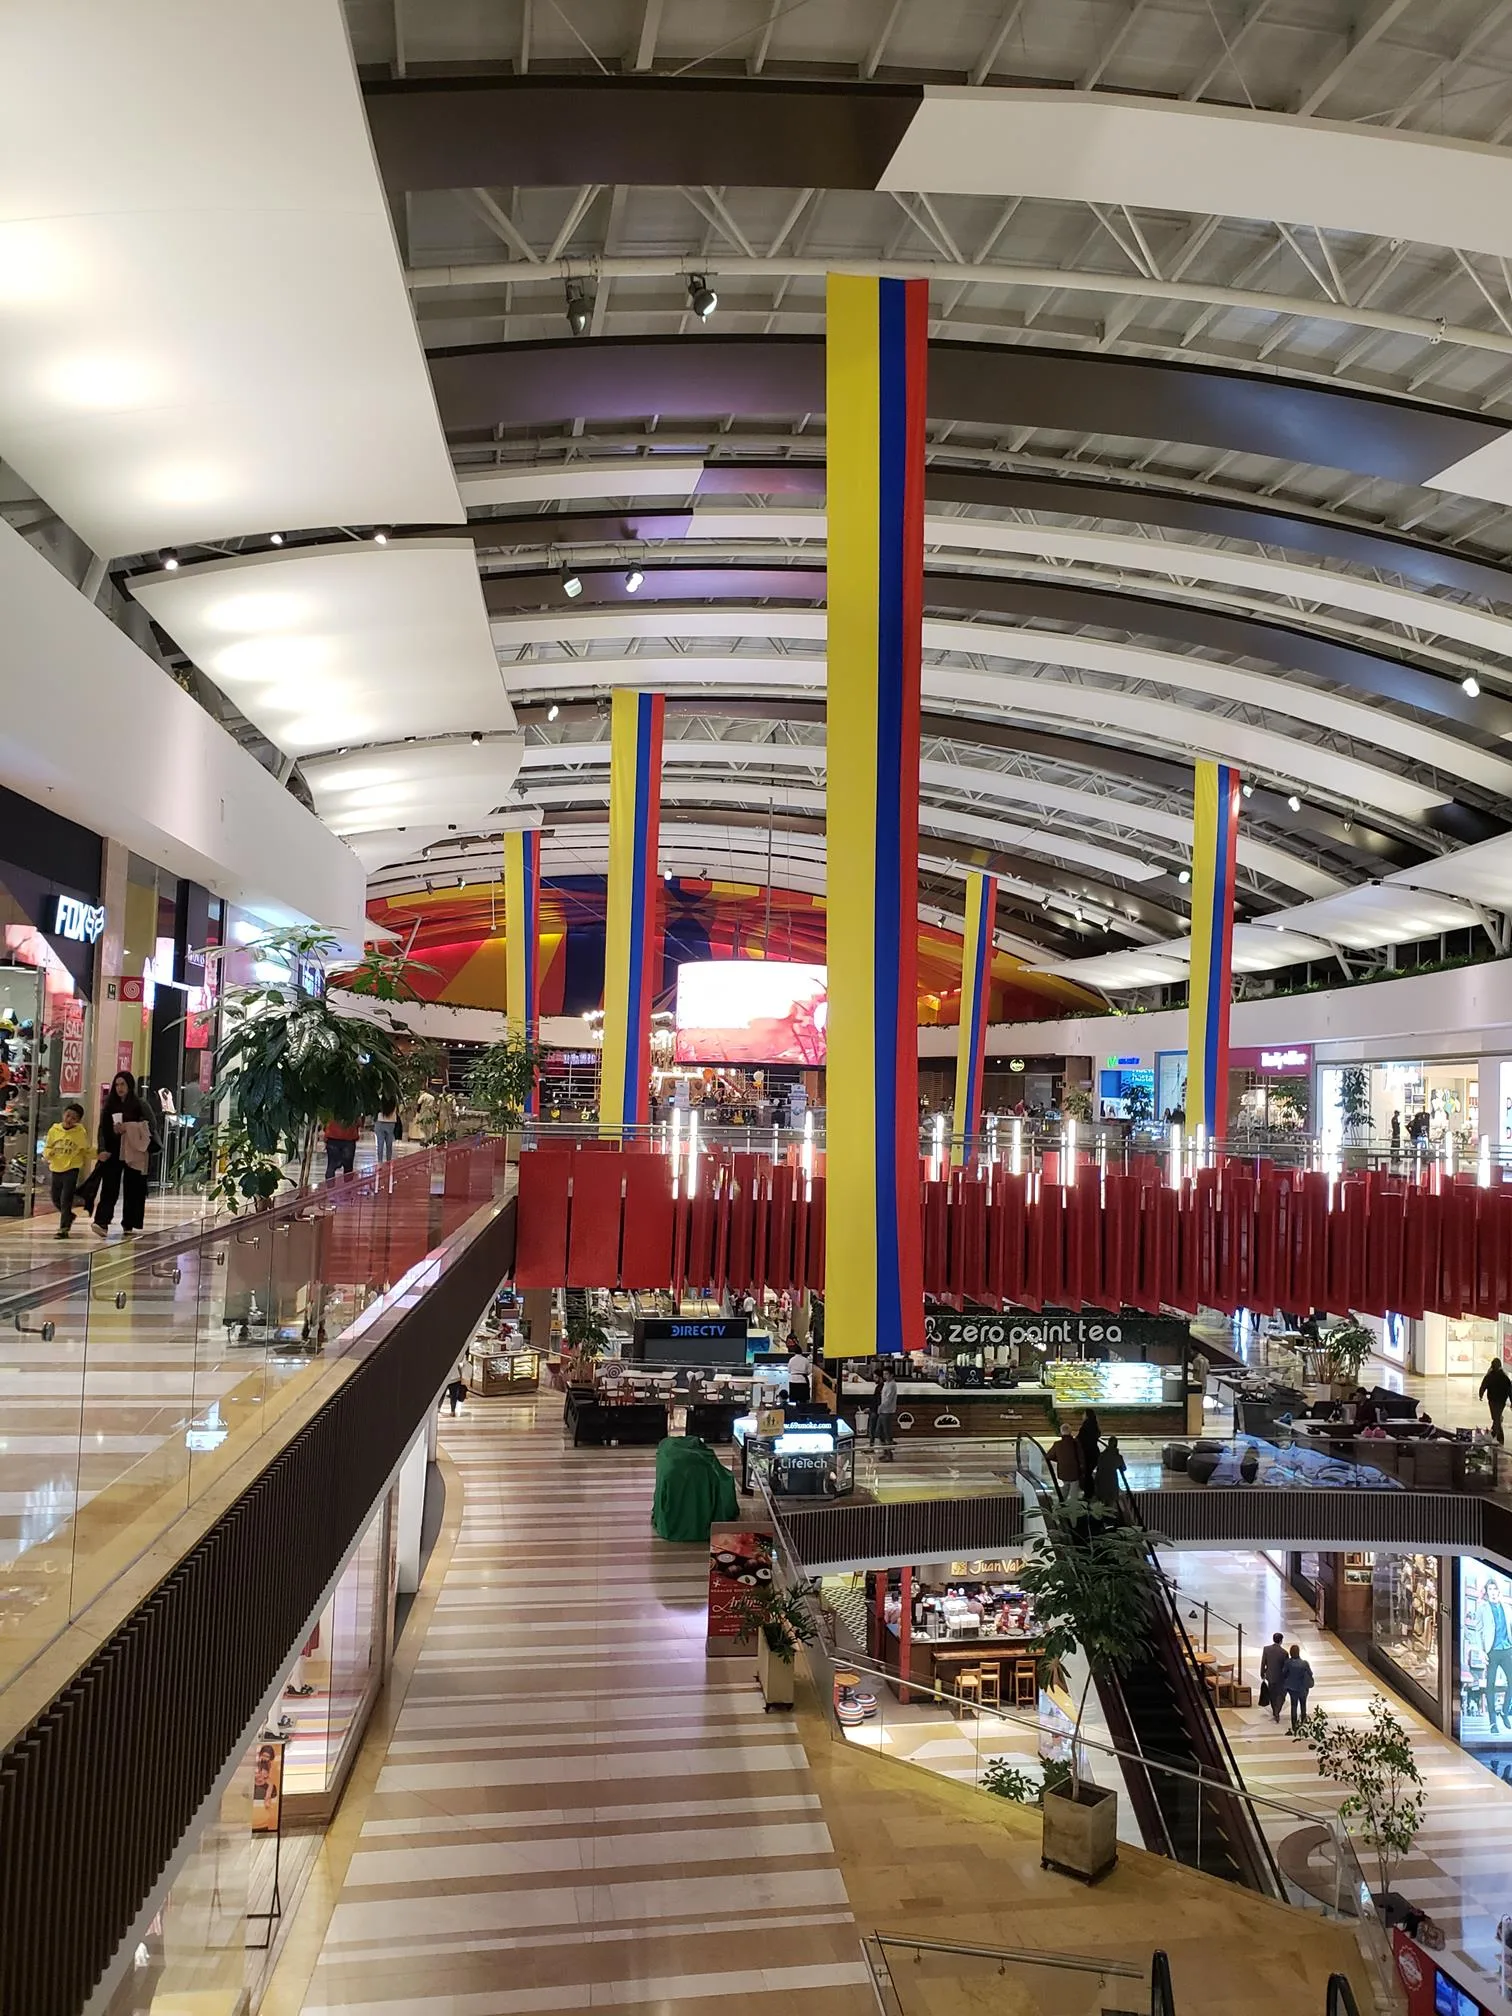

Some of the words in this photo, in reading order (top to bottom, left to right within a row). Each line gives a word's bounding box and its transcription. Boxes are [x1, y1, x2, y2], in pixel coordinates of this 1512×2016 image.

[55, 894, 90, 942] FOX
[671, 1325, 726, 1337] DIRECTV
[949, 1324, 1004, 1343] zero
[1010, 1320, 1072, 1350] point
[1078, 1320, 1122, 1343] tea
[781, 1457, 828, 1469] LifeTech
[969, 1559, 1001, 1575] Juan
